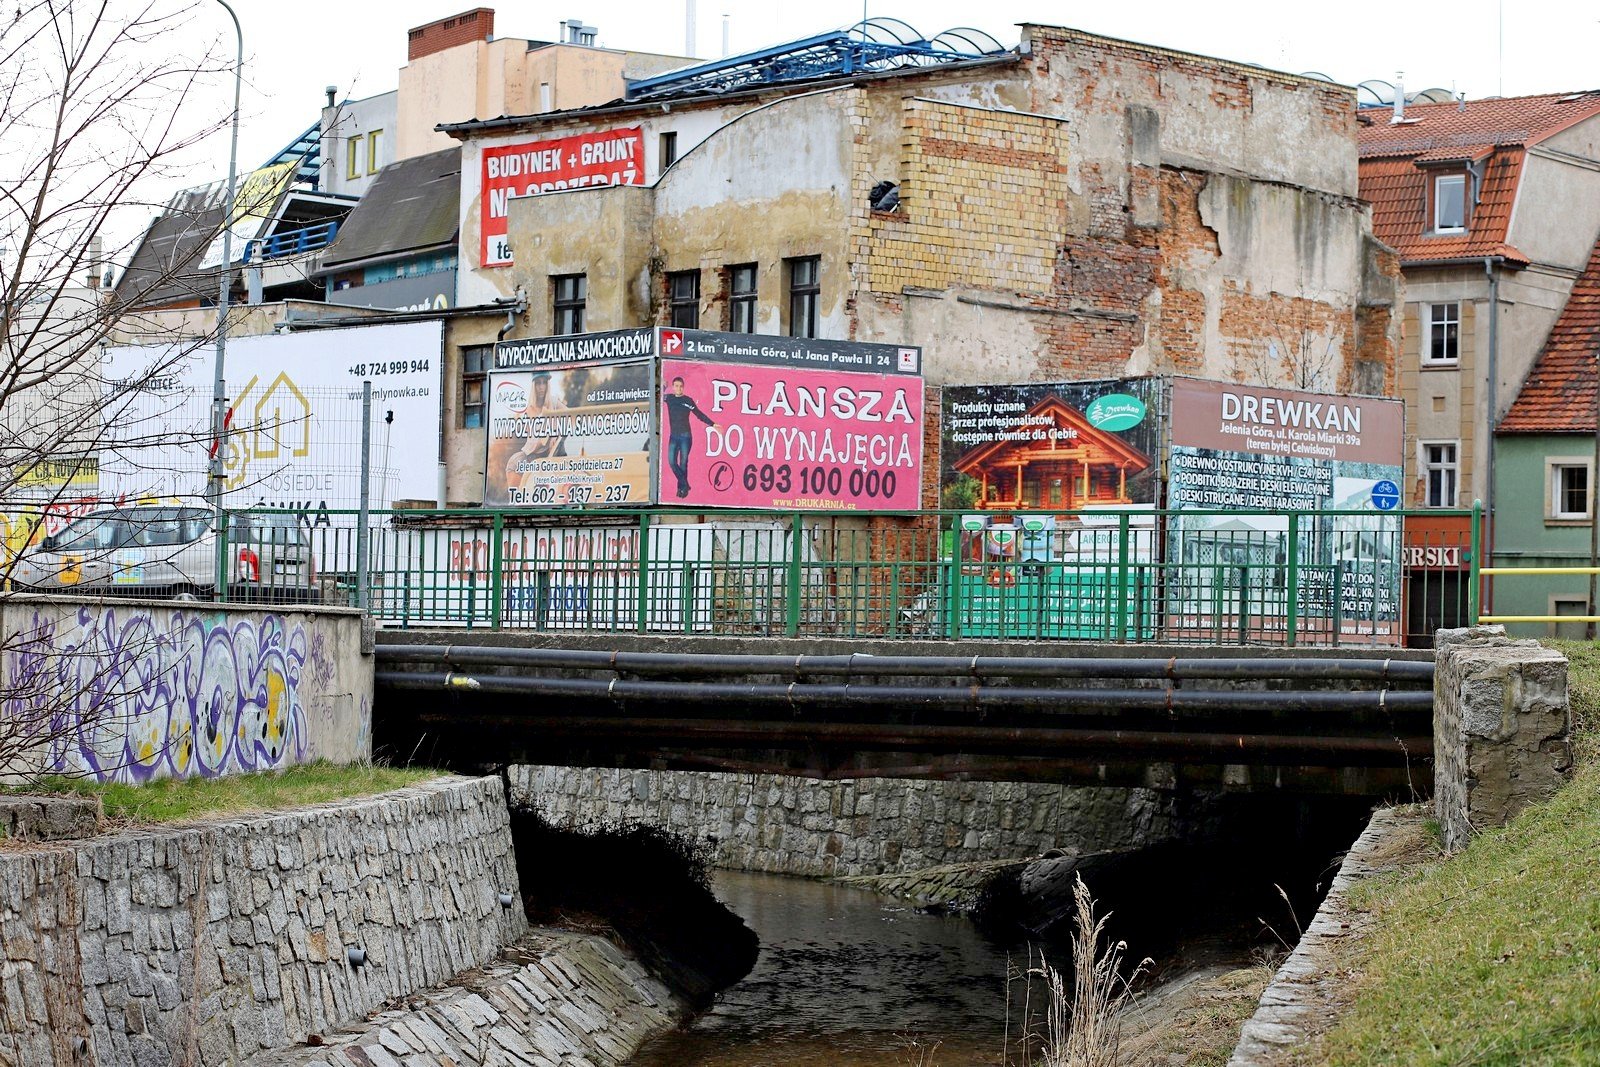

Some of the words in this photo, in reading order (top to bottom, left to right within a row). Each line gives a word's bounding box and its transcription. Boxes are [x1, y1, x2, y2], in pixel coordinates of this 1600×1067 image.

[488, 148, 562, 178] BUDYNEK
[581, 137, 637, 166] GRUNT
[499, 341, 576, 366] WYPOŻYCZALNIA
[578, 331, 651, 359] SAMOCHODÓW
[687, 341, 694, 351] 2
[698, 343, 715, 353] km
[722, 344, 758, 356] Jelenia
[761, 346, 789, 360] Góra,
[792, 349, 803, 359] ul.
[806, 350, 829, 362] Jana
[832, 352, 862, 364] Pawła
[877, 355, 890, 366] 24
[348, 362, 366, 376] +48
[369, 362, 387, 375] 724
[389, 361, 407, 374] 999
[410, 360, 429, 372] 944
[587, 393, 595, 402] od
[597, 391, 604, 401] 15
[606, 390, 614, 400] lat
[711, 378, 915, 424] PLANSZA
[952, 402, 993, 415] Produkty
[994, 402, 1026, 412] uznane
[1106, 404, 1140, 417] Drewkan
[1221, 392, 1361, 433] DREWKAN
[494, 413, 573, 439] WYPOŻYCZALNIA
[575, 408, 650, 436] SAMOCHODÓW
[952, 418, 977, 429] przez
[978, 415, 1055, 429] profesjonalistów,
[952, 430, 993, 445] dostępne
[995, 429, 1030, 442] również
[1033, 429, 1046, 440] dla
[1048, 428, 1077, 440] Ciebie
[1220, 422, 1251, 435] Jelenia
[1252, 426, 1274, 438] Góra,
[1276, 428, 1287, 439] ul.
[1288, 430, 1316, 442] Karola
[1317, 433, 1344, 444] Miarki
[1345, 435, 1360, 446] 39a
[706, 424, 744, 458] DO
[753, 426, 914, 472] WYNAJĘCIA
[1246, 437, 1270, 450] (teren
[1271, 440, 1290, 454] byłej
[1291, 441, 1336, 458] Celwiskozy)
[516, 461, 540, 472] Jelenia
[541, 460, 558, 471] Góra
[560, 460, 568, 471] ul.
[569, 459, 612, 472] Spółdzielcza
[614, 458, 623, 469] 27
[1181, 457, 1218, 470] DREWNO
[1218, 460, 1276, 475] KOSTRUKCYJNE
[1277, 464, 1292, 476] KVH
[1317, 468, 1331, 480] BSH
[273, 474, 333, 492] OSIEDLE
[743, 464, 792, 493] 693
[800, 467, 842, 496] 100
[849, 468, 896, 498] 000
[1181, 473, 1220, 488] PODBITKI,
[1221, 478, 1260, 492] BOAZERIE,
[1261, 480, 1282, 492] DESKI
[1283, 482, 1329, 496] ELEWACYJNE
[532, 488, 554, 503] 602
[569, 488, 592, 503] 137
[606, 485, 630, 502] 237
[772, 498, 856, 510] www.DRUKARNIA.cz
[1180, 490, 1203, 502] DESKI
[1204, 492, 1244, 506] STRUGANE
[1250, 495, 1272, 507] DESKI
[1272, 497, 1314, 509] TARASOWE
